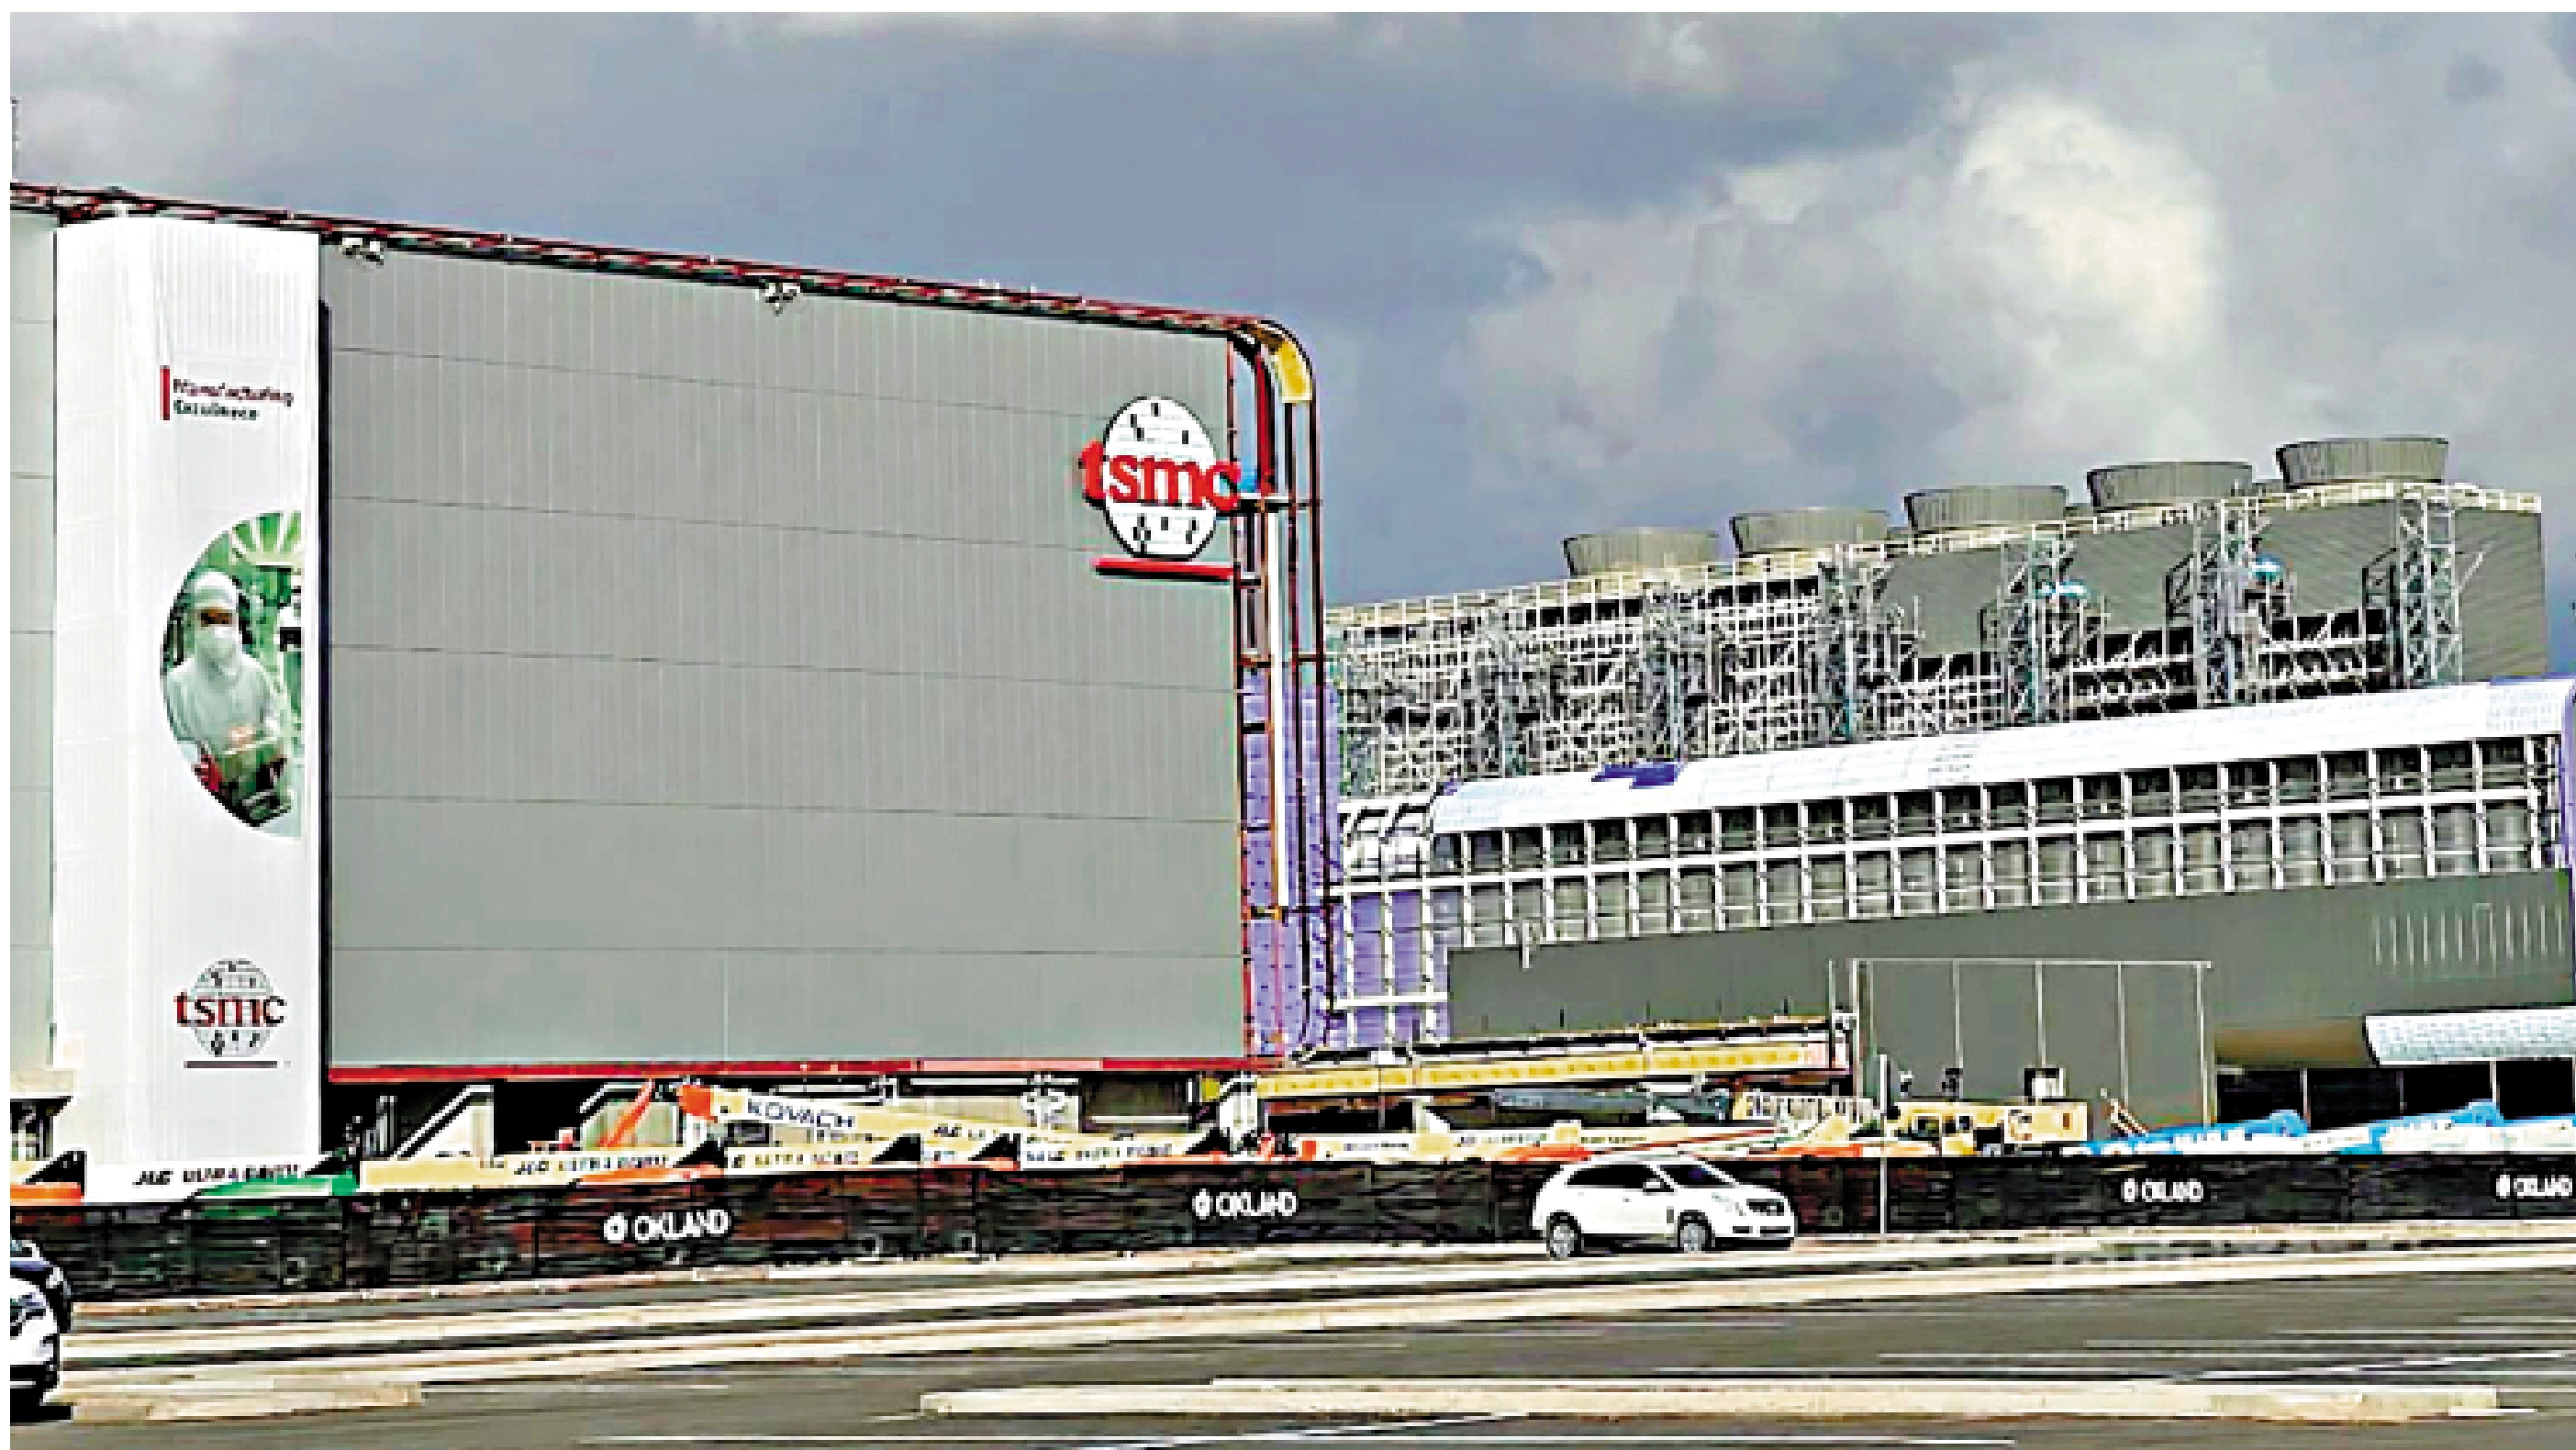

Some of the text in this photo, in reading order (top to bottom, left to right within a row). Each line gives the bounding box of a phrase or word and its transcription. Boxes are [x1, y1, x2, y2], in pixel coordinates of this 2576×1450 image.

[1080, 440, 1241, 512] tsmc
[173, 990, 288, 1027] tsmc
[747, 1099, 855, 1130] KOVACH
[1218, 1190, 1298, 1219] OKLAND
[632, 1209, 730, 1242] OKLAND
